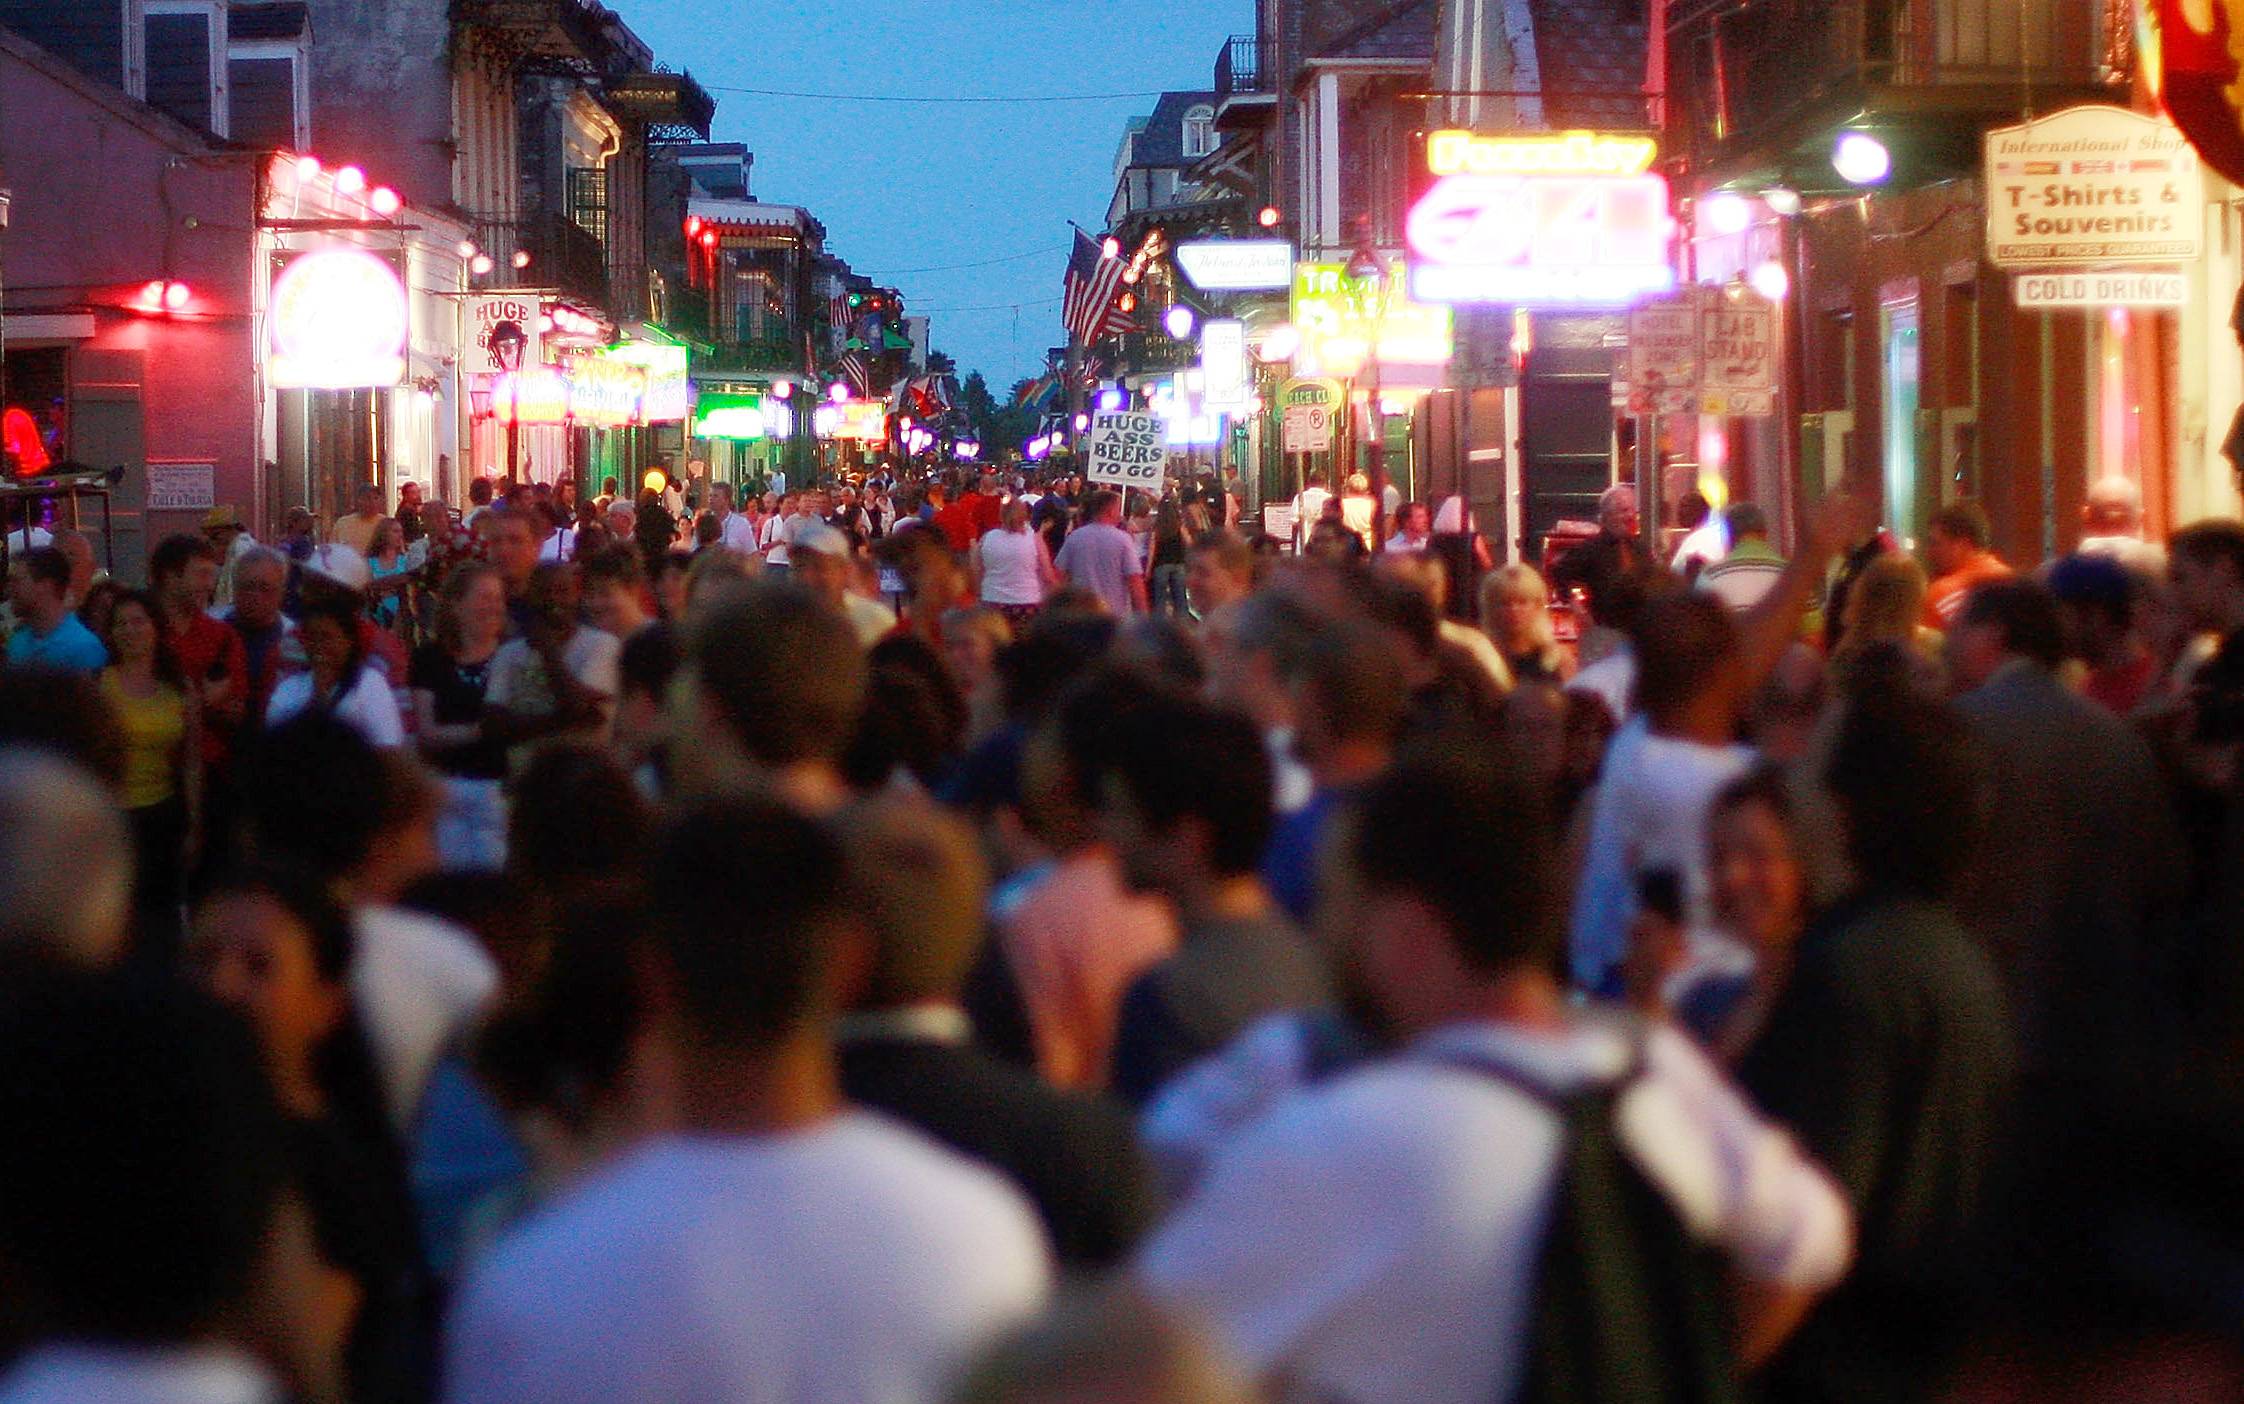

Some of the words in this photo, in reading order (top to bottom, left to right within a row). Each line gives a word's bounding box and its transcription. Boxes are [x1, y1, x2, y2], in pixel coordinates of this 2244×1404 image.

[2000, 138, 2130, 154] International
[2005, 183, 2142, 207] T-Shirts
[2160, 182, 2179, 204] &
[2015, 212, 2173, 236] Souvenirs
[2025, 279, 2087, 301] COLD
[2096, 277, 2184, 300] DRINKS
[475, 301, 529, 321] HUGE
[1097, 414, 1163, 434] HUGE
[1103, 430, 1155, 446] ASS
[1093, 442, 1164, 463] BEERS
[1096, 462, 1121, 475] TO
[1127, 464, 1157, 479] GO
